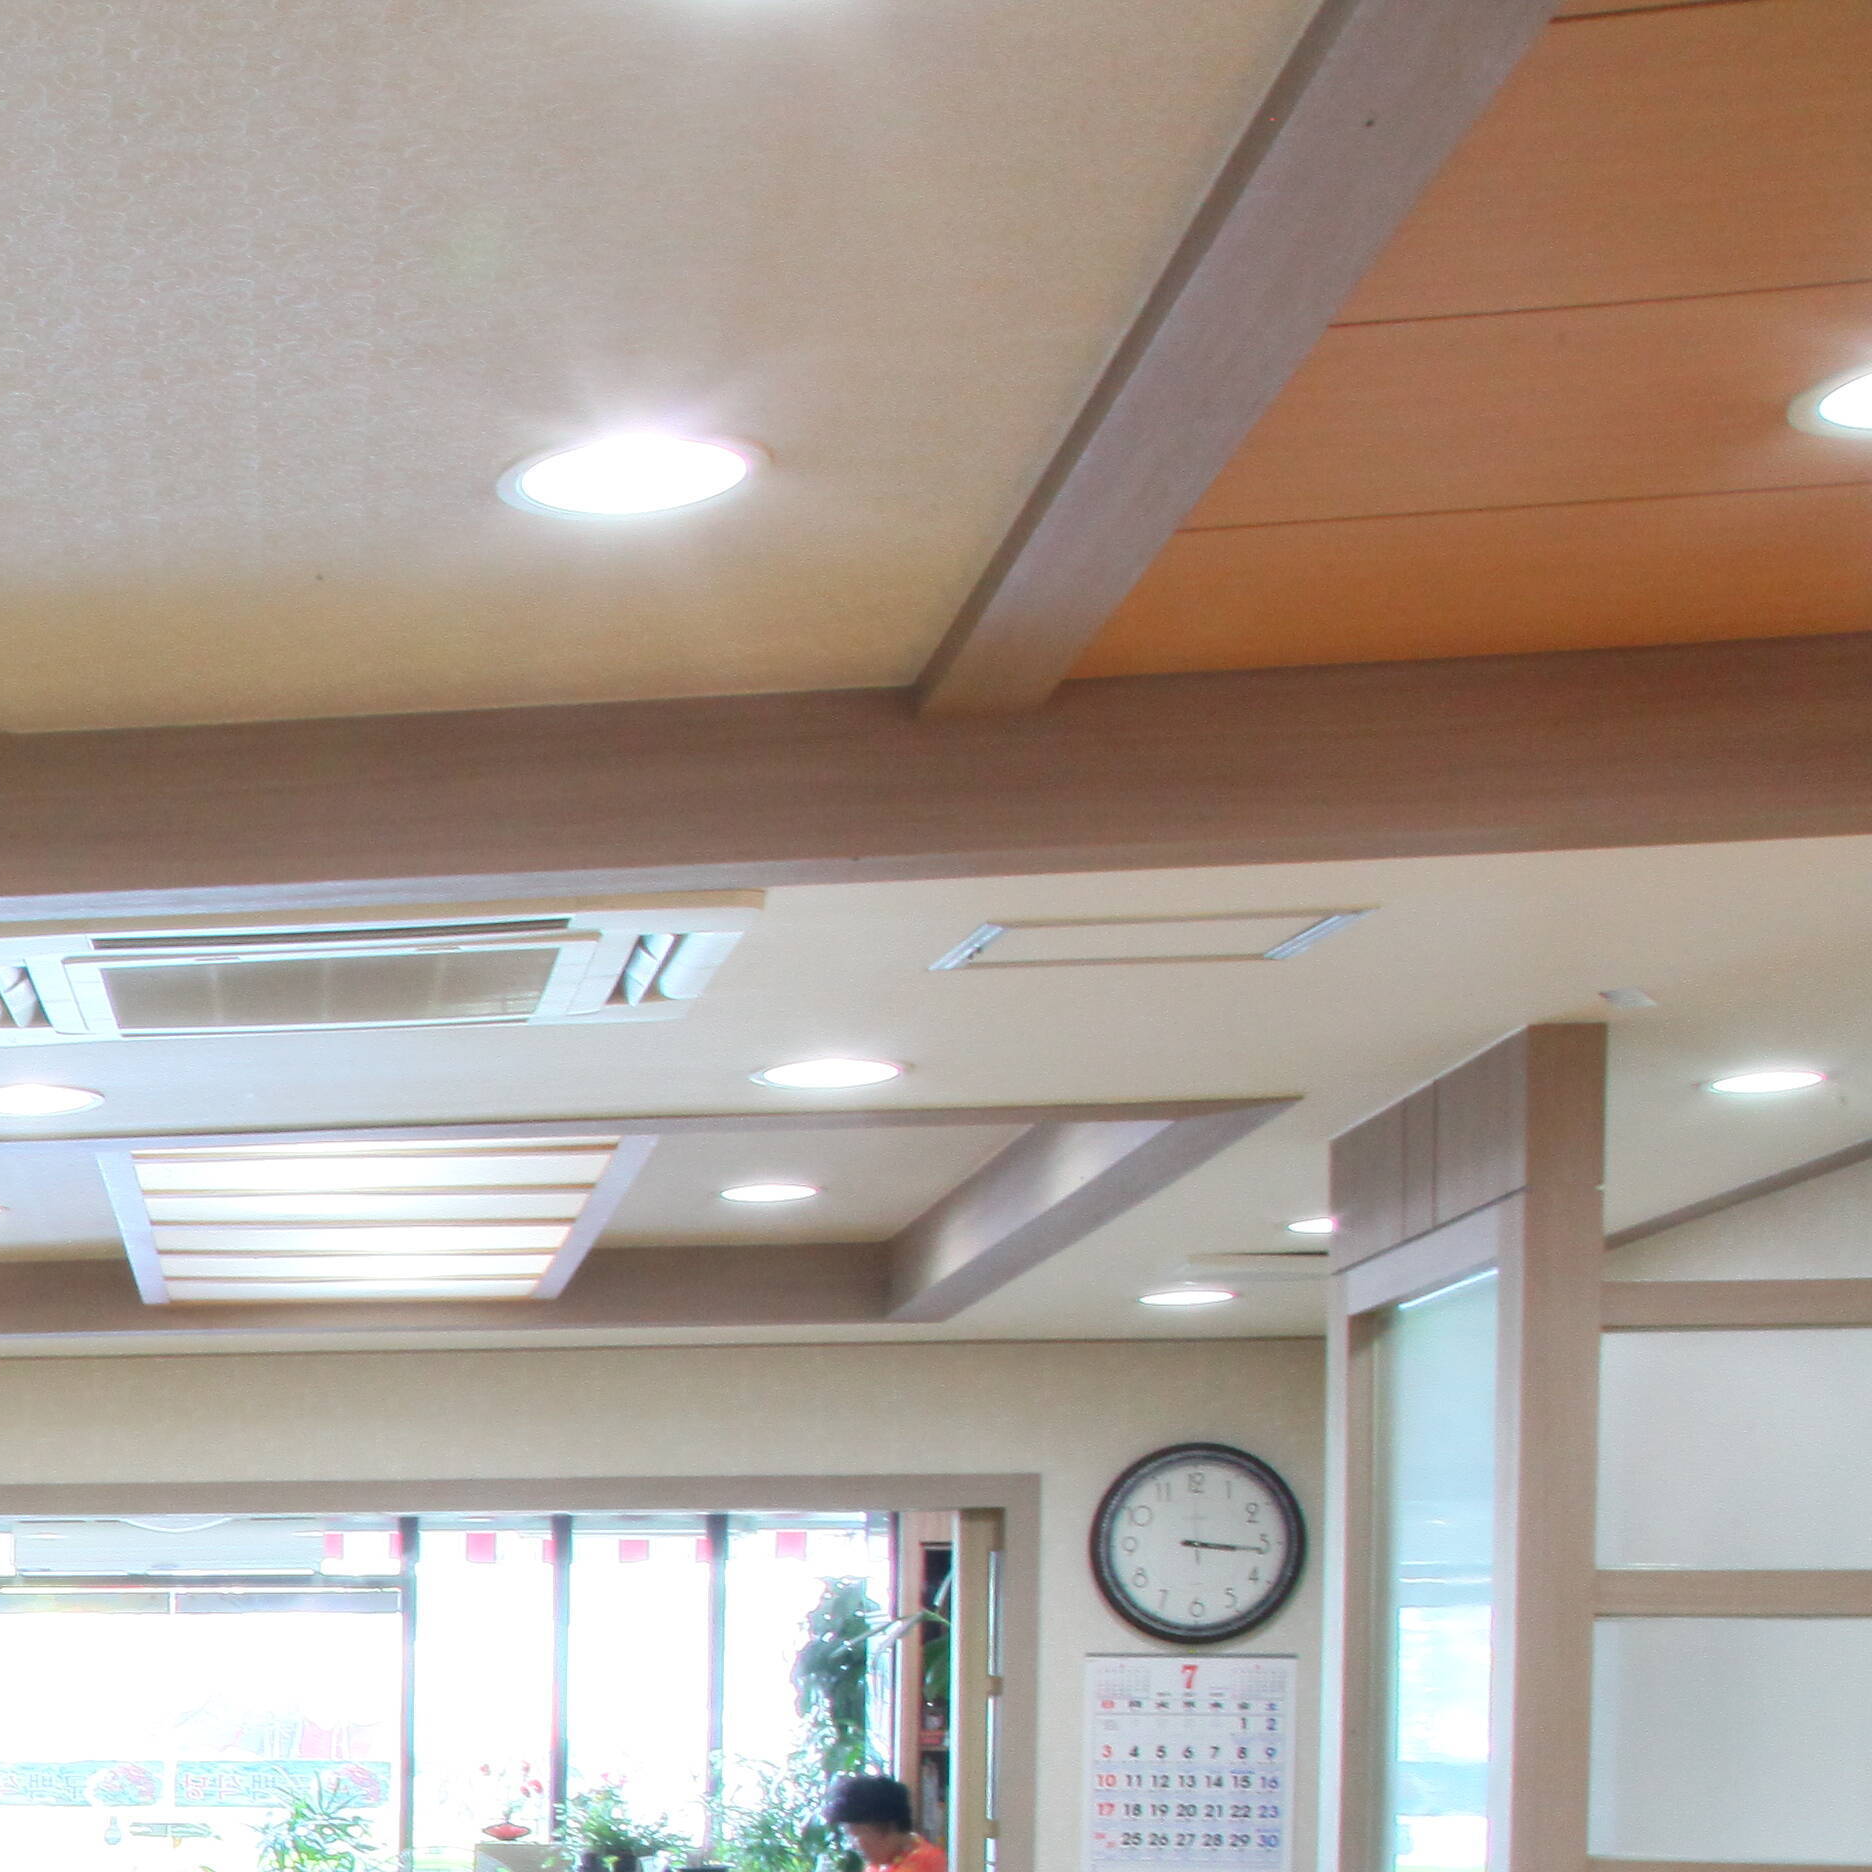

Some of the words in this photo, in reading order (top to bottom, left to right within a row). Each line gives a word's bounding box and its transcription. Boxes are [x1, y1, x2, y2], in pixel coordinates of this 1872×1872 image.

[1188, 1472, 1204, 1493] 12
[1127, 1504, 1152, 1526] 10
[1245, 1502, 1259, 1523] 2
[1132, 1567, 1148, 1588] 8
[1248, 1567, 1259, 1581] 4
[1225, 1587, 1238, 1609] 5
[1188, 1600, 1204, 1617] 6
[1181, 1664, 1198, 1689] 7
[1239, 1717, 1247, 1729] 1
[1265, 1718, 1277, 1731] 2
[1102, 1745, 1113, 1758] 3
[1128, 1746, 1140, 1758] 4
[1155, 1746, 1167, 1759] 5
[1182, 1747, 1194, 1759] 6
[1209, 1746, 1220, 1759] 7
[1237, 1747, 1248, 1760] 8
[1265, 1747, 1277, 1760] 9
[1097, 1774, 1117, 1787] 10
[1126, 1774, 1142, 1787] 11
[1151, 1775, 1170, 1788] 12
[1178, 1775, 1196, 1788] 13
[1205, 1775, 1223, 1788] 14
[1232, 1775, 1251, 1788] 15
[1259, 1776, 1279, 1789] 16
[1097, 1803, 1115, 1816] 17
[1124, 1803, 1142, 1816] 18
[1150, 1803, 1169, 1817] 19
[1176, 1804, 1197, 1817] 20
[1204, 1804, 1223, 1817] 21
[1230, 1805, 1251, 1818] 22
[1258, 1805, 1279, 1818] 23
[1121, 1833, 1142, 1846] 25
[1148, 1833, 1169, 1846] 26
[1175, 1833, 1196, 1847] 27
[1202, 1833, 1223, 1847] 28
[1229, 1834, 1250, 1847] 29
[1257, 1834, 1279, 1848] 30
